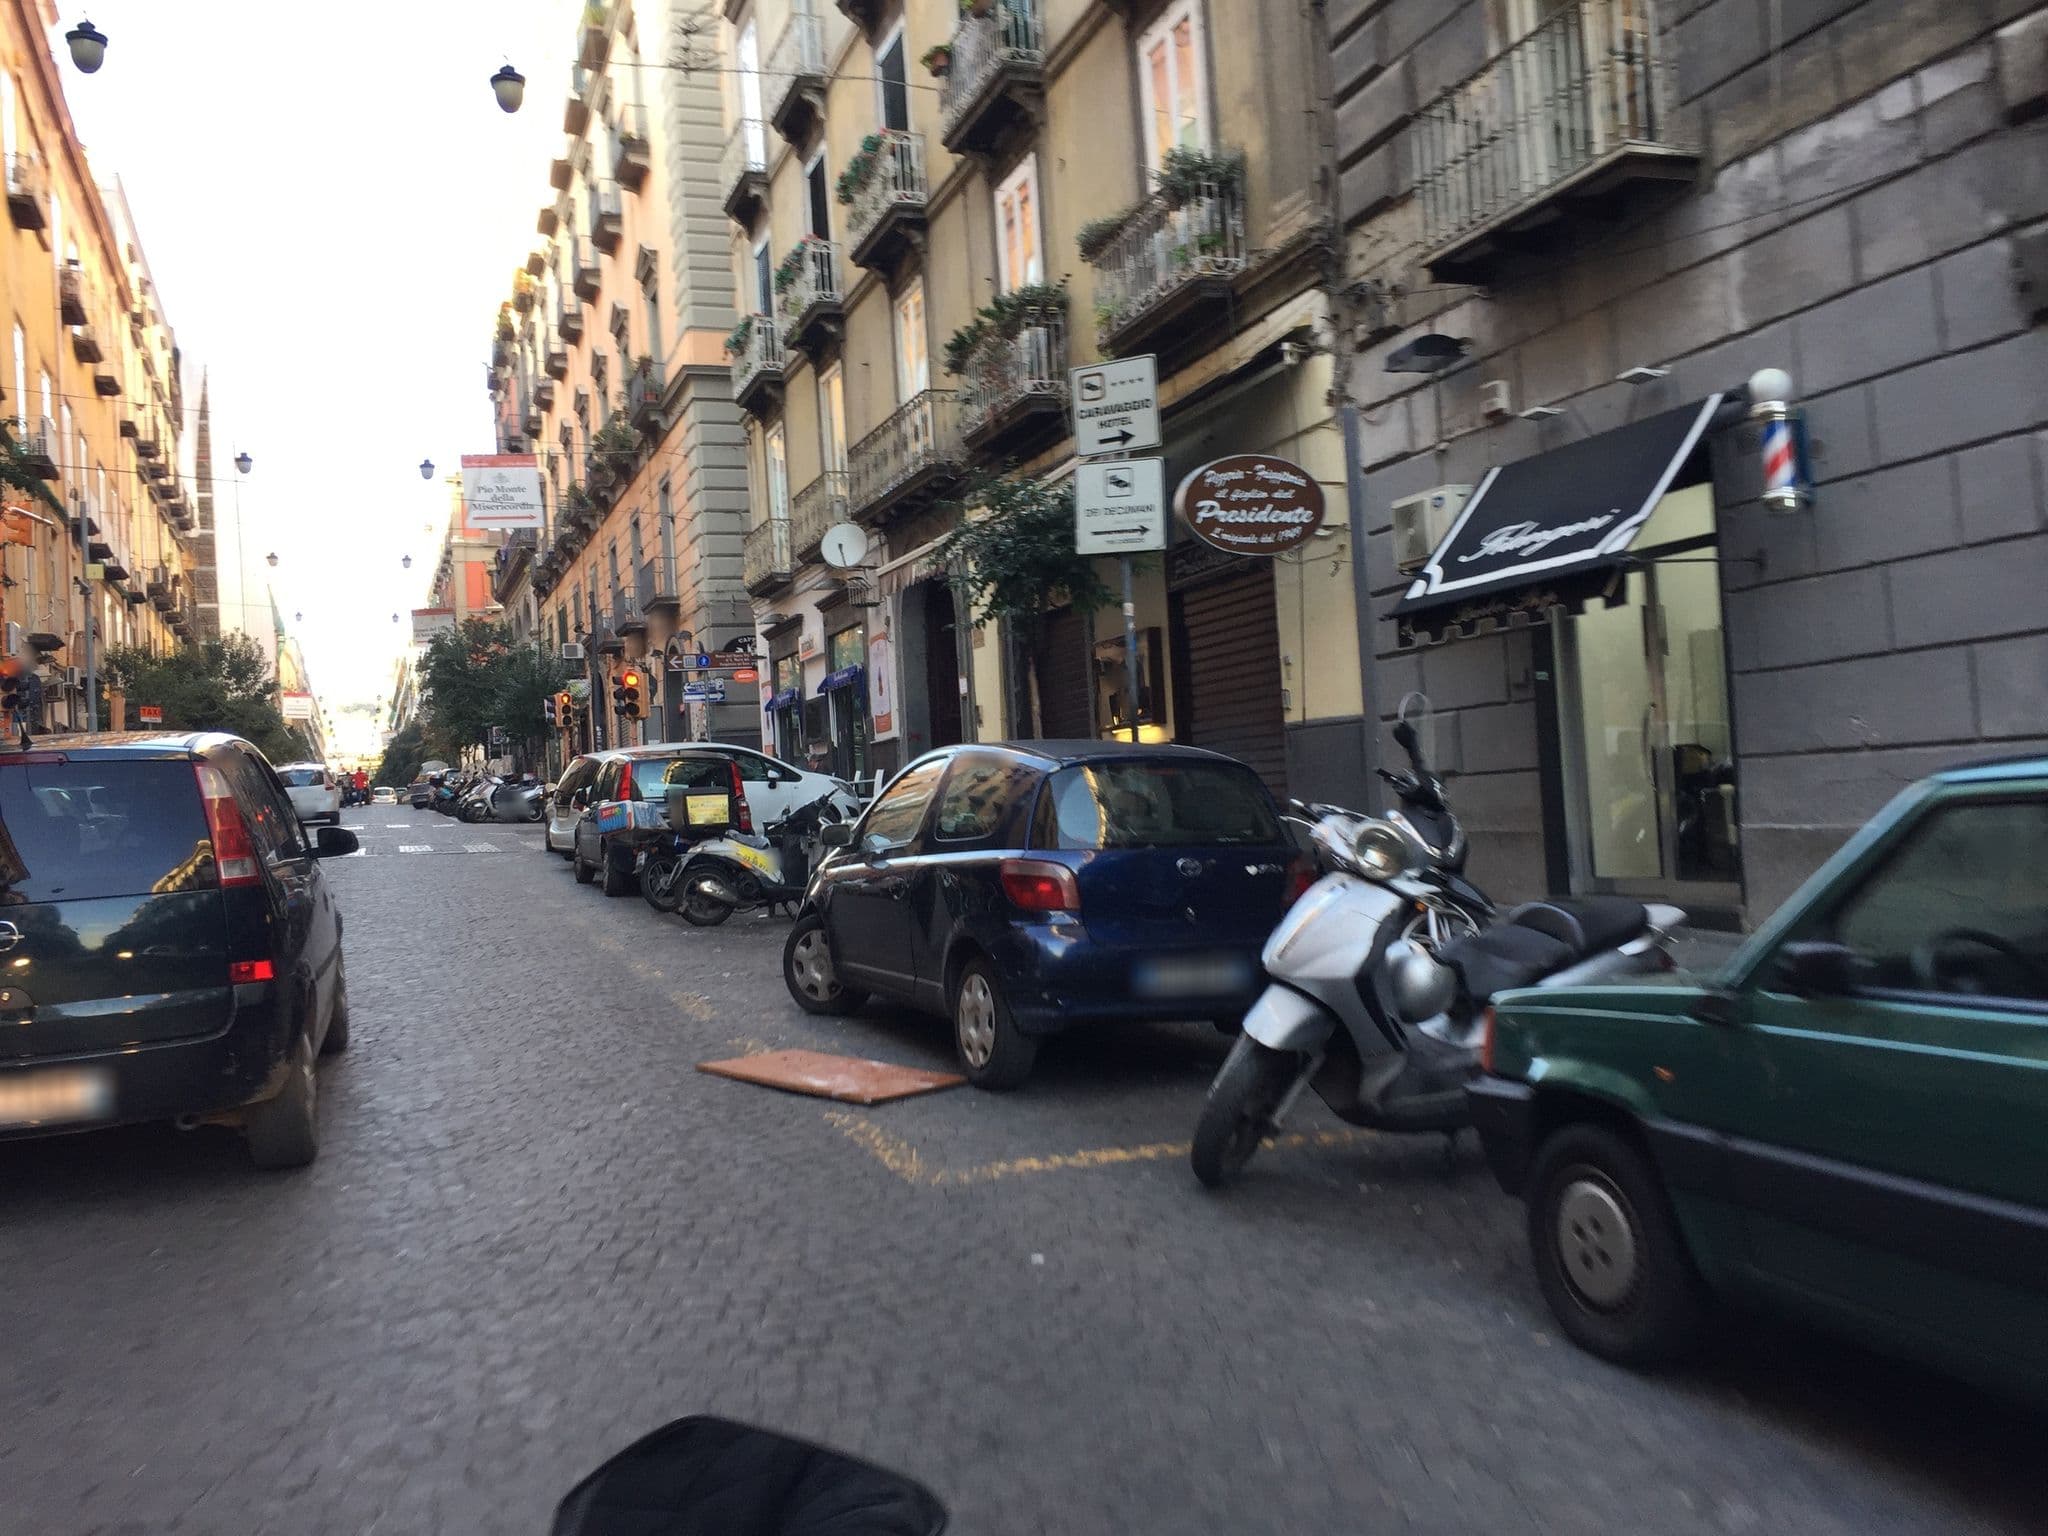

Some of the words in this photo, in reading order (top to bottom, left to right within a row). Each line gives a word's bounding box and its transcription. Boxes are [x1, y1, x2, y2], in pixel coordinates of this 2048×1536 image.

[1098, 417, 1133, 429] HOTEL
[477, 485, 493, 493] Pio
[495, 485, 527, 493] Monte
[490, 493, 515, 502] della
[472, 502, 535, 511] Misericordia
[1195, 500, 1314, 523] Presidente
